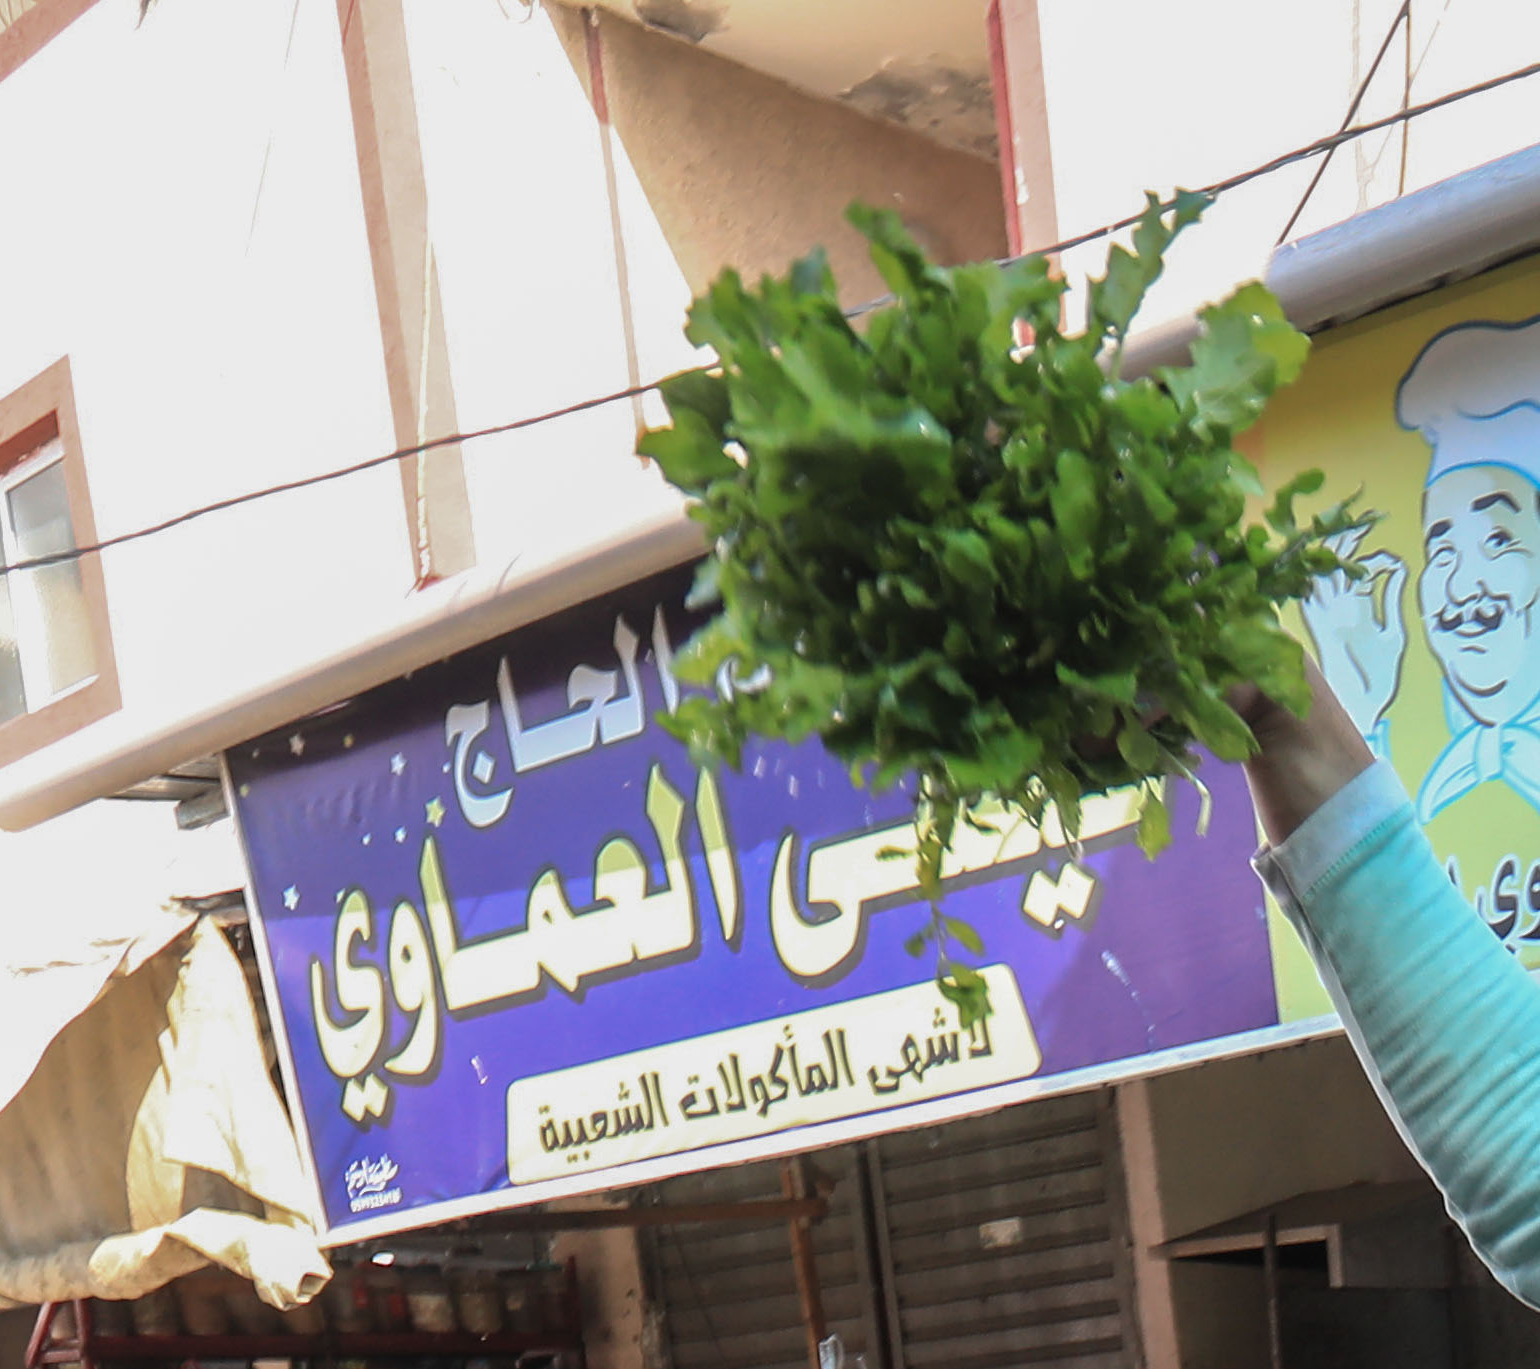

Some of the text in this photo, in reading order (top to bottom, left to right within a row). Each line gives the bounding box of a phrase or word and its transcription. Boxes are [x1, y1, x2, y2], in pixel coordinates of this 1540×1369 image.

[445, 606, 678, 824] الحاج
[312, 765, 737, 1119] العماوي
[540, 1071, 669, 1161] الشعبية
[679, 1024, 854, 1118] المأكولات
